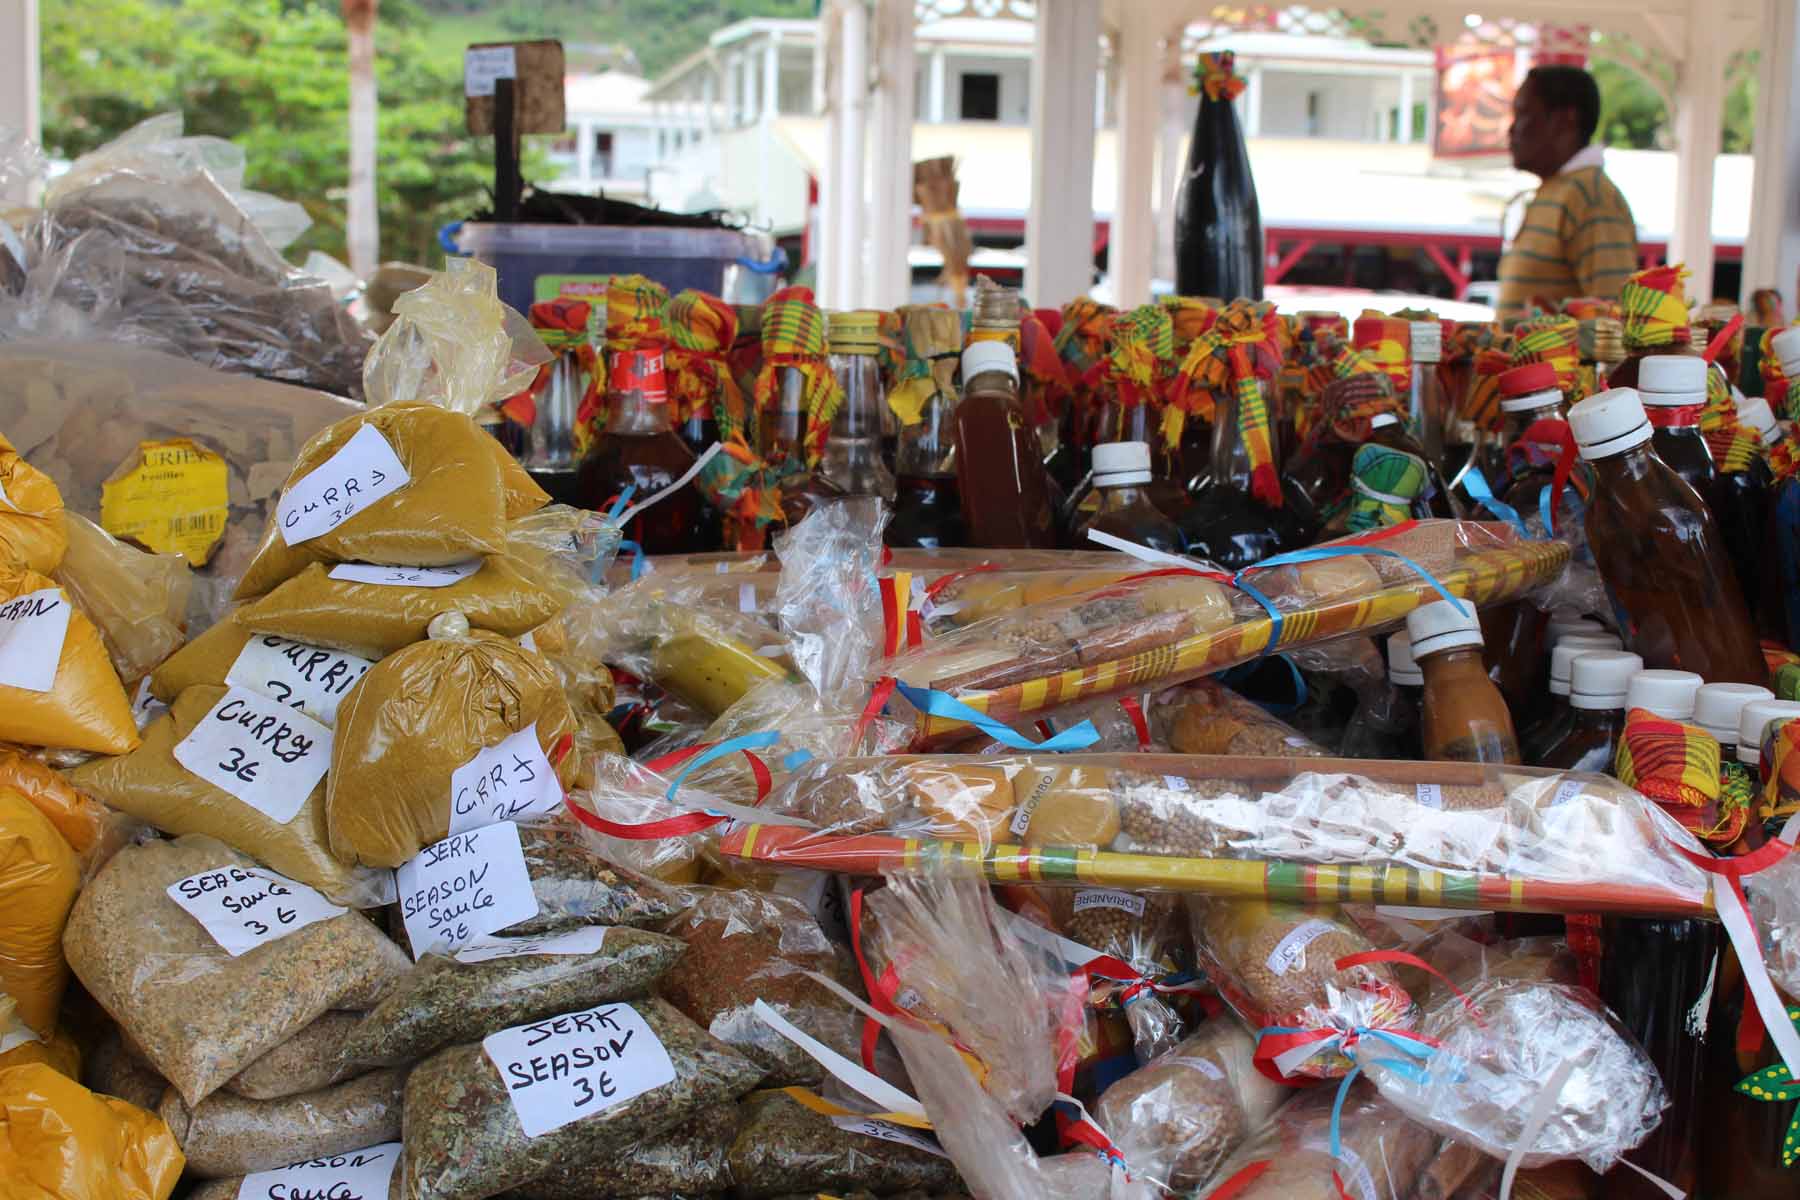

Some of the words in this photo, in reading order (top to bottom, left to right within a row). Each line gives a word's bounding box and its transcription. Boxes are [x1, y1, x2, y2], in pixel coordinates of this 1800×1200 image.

[1017, 775, 1053, 831] COLOMBO
[422, 833, 480, 868] JERK
[404, 862, 489, 920] SEASON
[521, 1007, 621, 1047] JERK
[507, 1029, 634, 1090] SEASON
